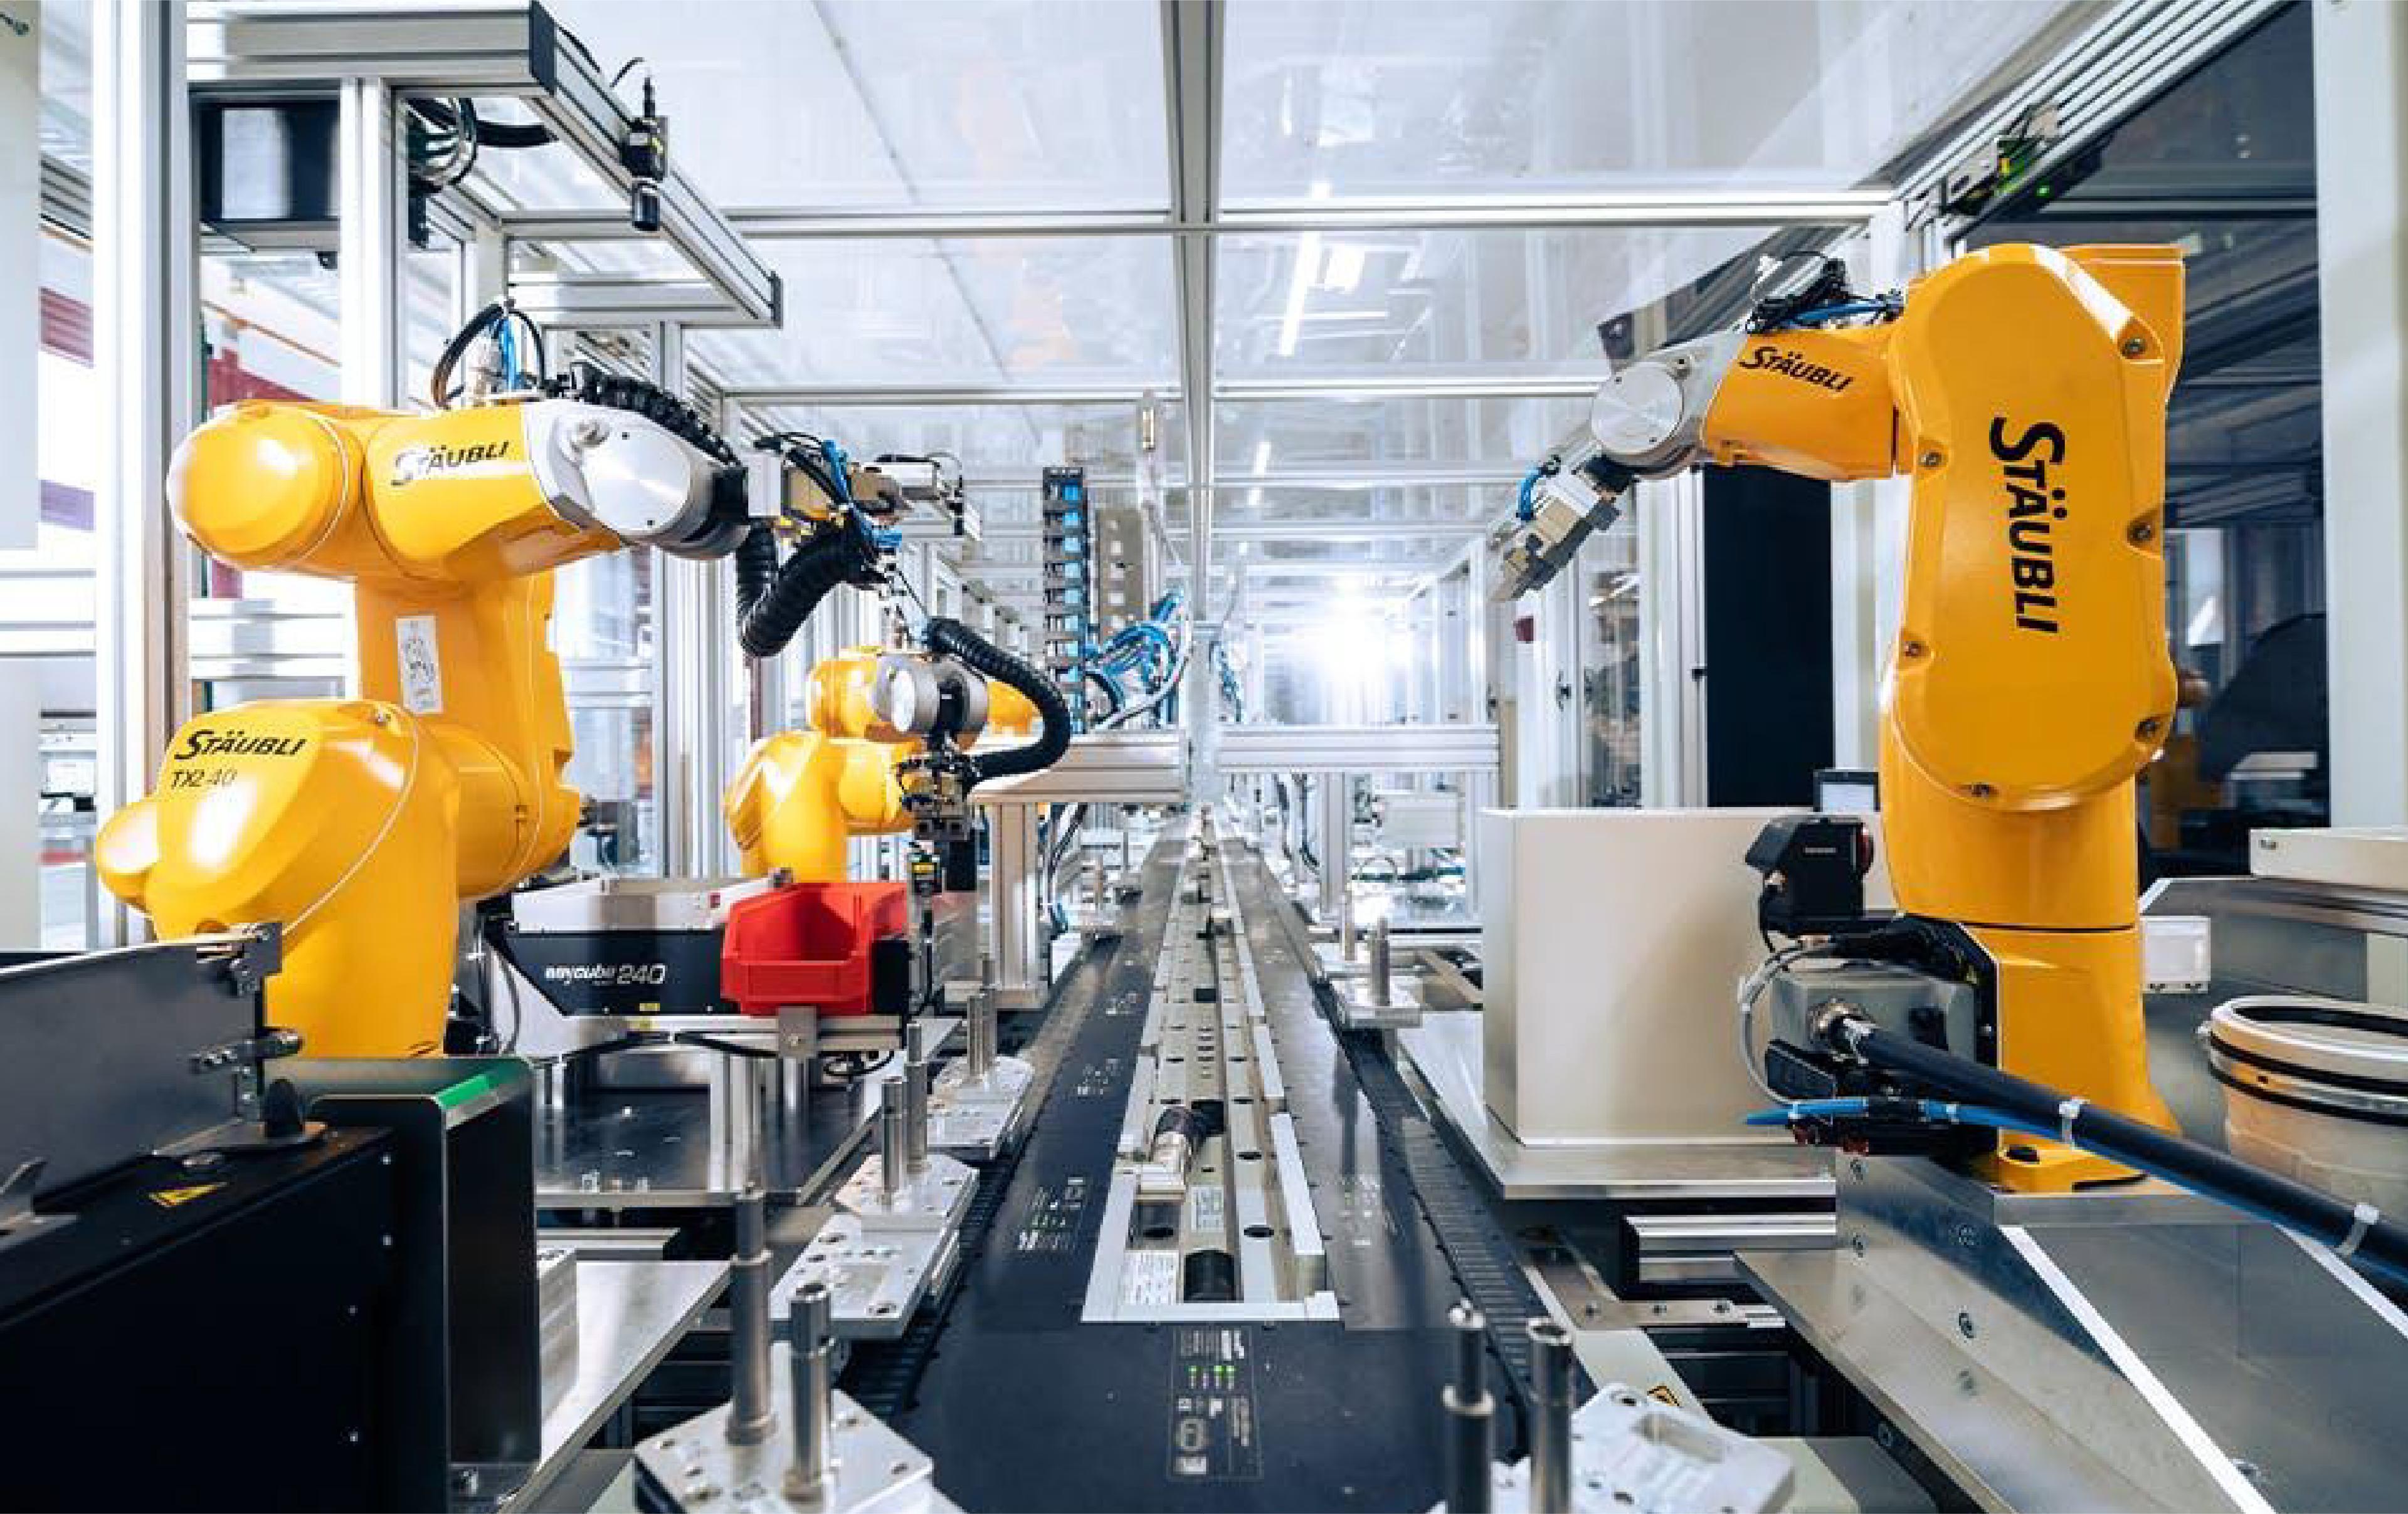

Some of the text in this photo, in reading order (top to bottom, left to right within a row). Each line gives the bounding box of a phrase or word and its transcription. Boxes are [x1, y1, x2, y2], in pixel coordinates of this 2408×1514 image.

[1738, 346, 1854, 392] STÄUBLI
[1990, 417, 2067, 633] STÄUBLI
[174, 729, 307, 760] STÄUBLI
[616, 964, 666, 984] 240
